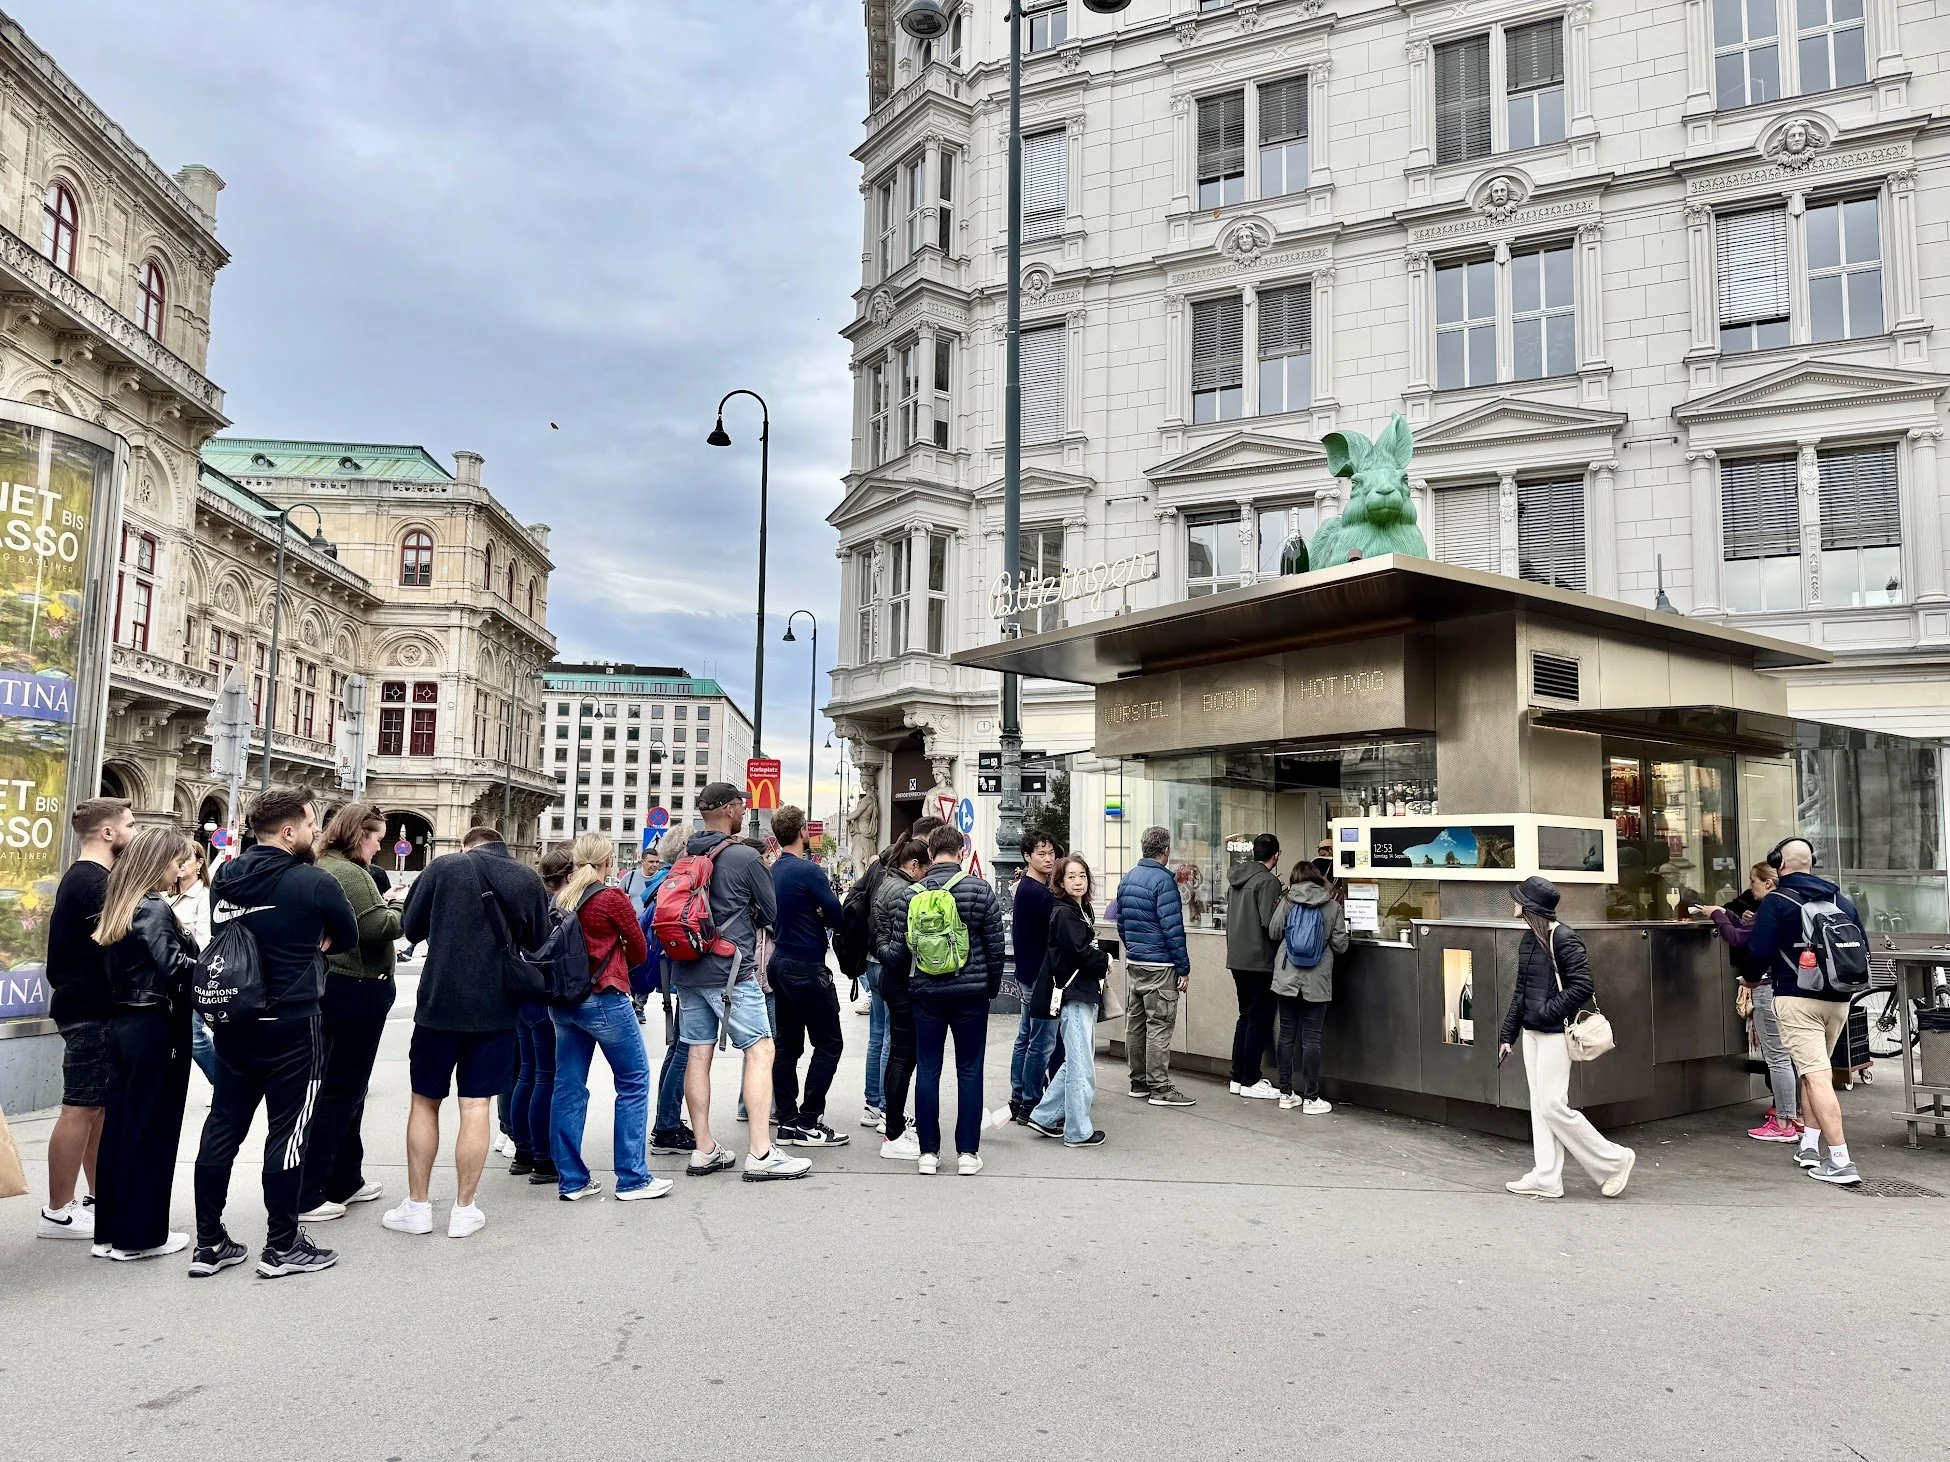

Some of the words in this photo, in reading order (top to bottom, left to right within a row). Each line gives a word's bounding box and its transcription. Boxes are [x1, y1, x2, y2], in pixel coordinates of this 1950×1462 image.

[62, 509, 84, 531] BIS
[0, 519, 79, 562] SSO
[18, 555, 73, 574] BATLINER
[1300, 676, 1338, 700] HOT
[1343, 670, 1384, 694] DOG
[1202, 687, 1257, 712] BOSNA
[1103, 700, 1169, 725] WÜRSTEL
[749, 766, 779, 774] Karlsplatz
[35, 796, 59, 813] BIS
[0, 816, 53, 849] SO
[1373, 843, 1393, 853] 12:53
[194, 985, 239, 997] CHAMPIONS
[198, 995, 229, 1004] LEAGUE
